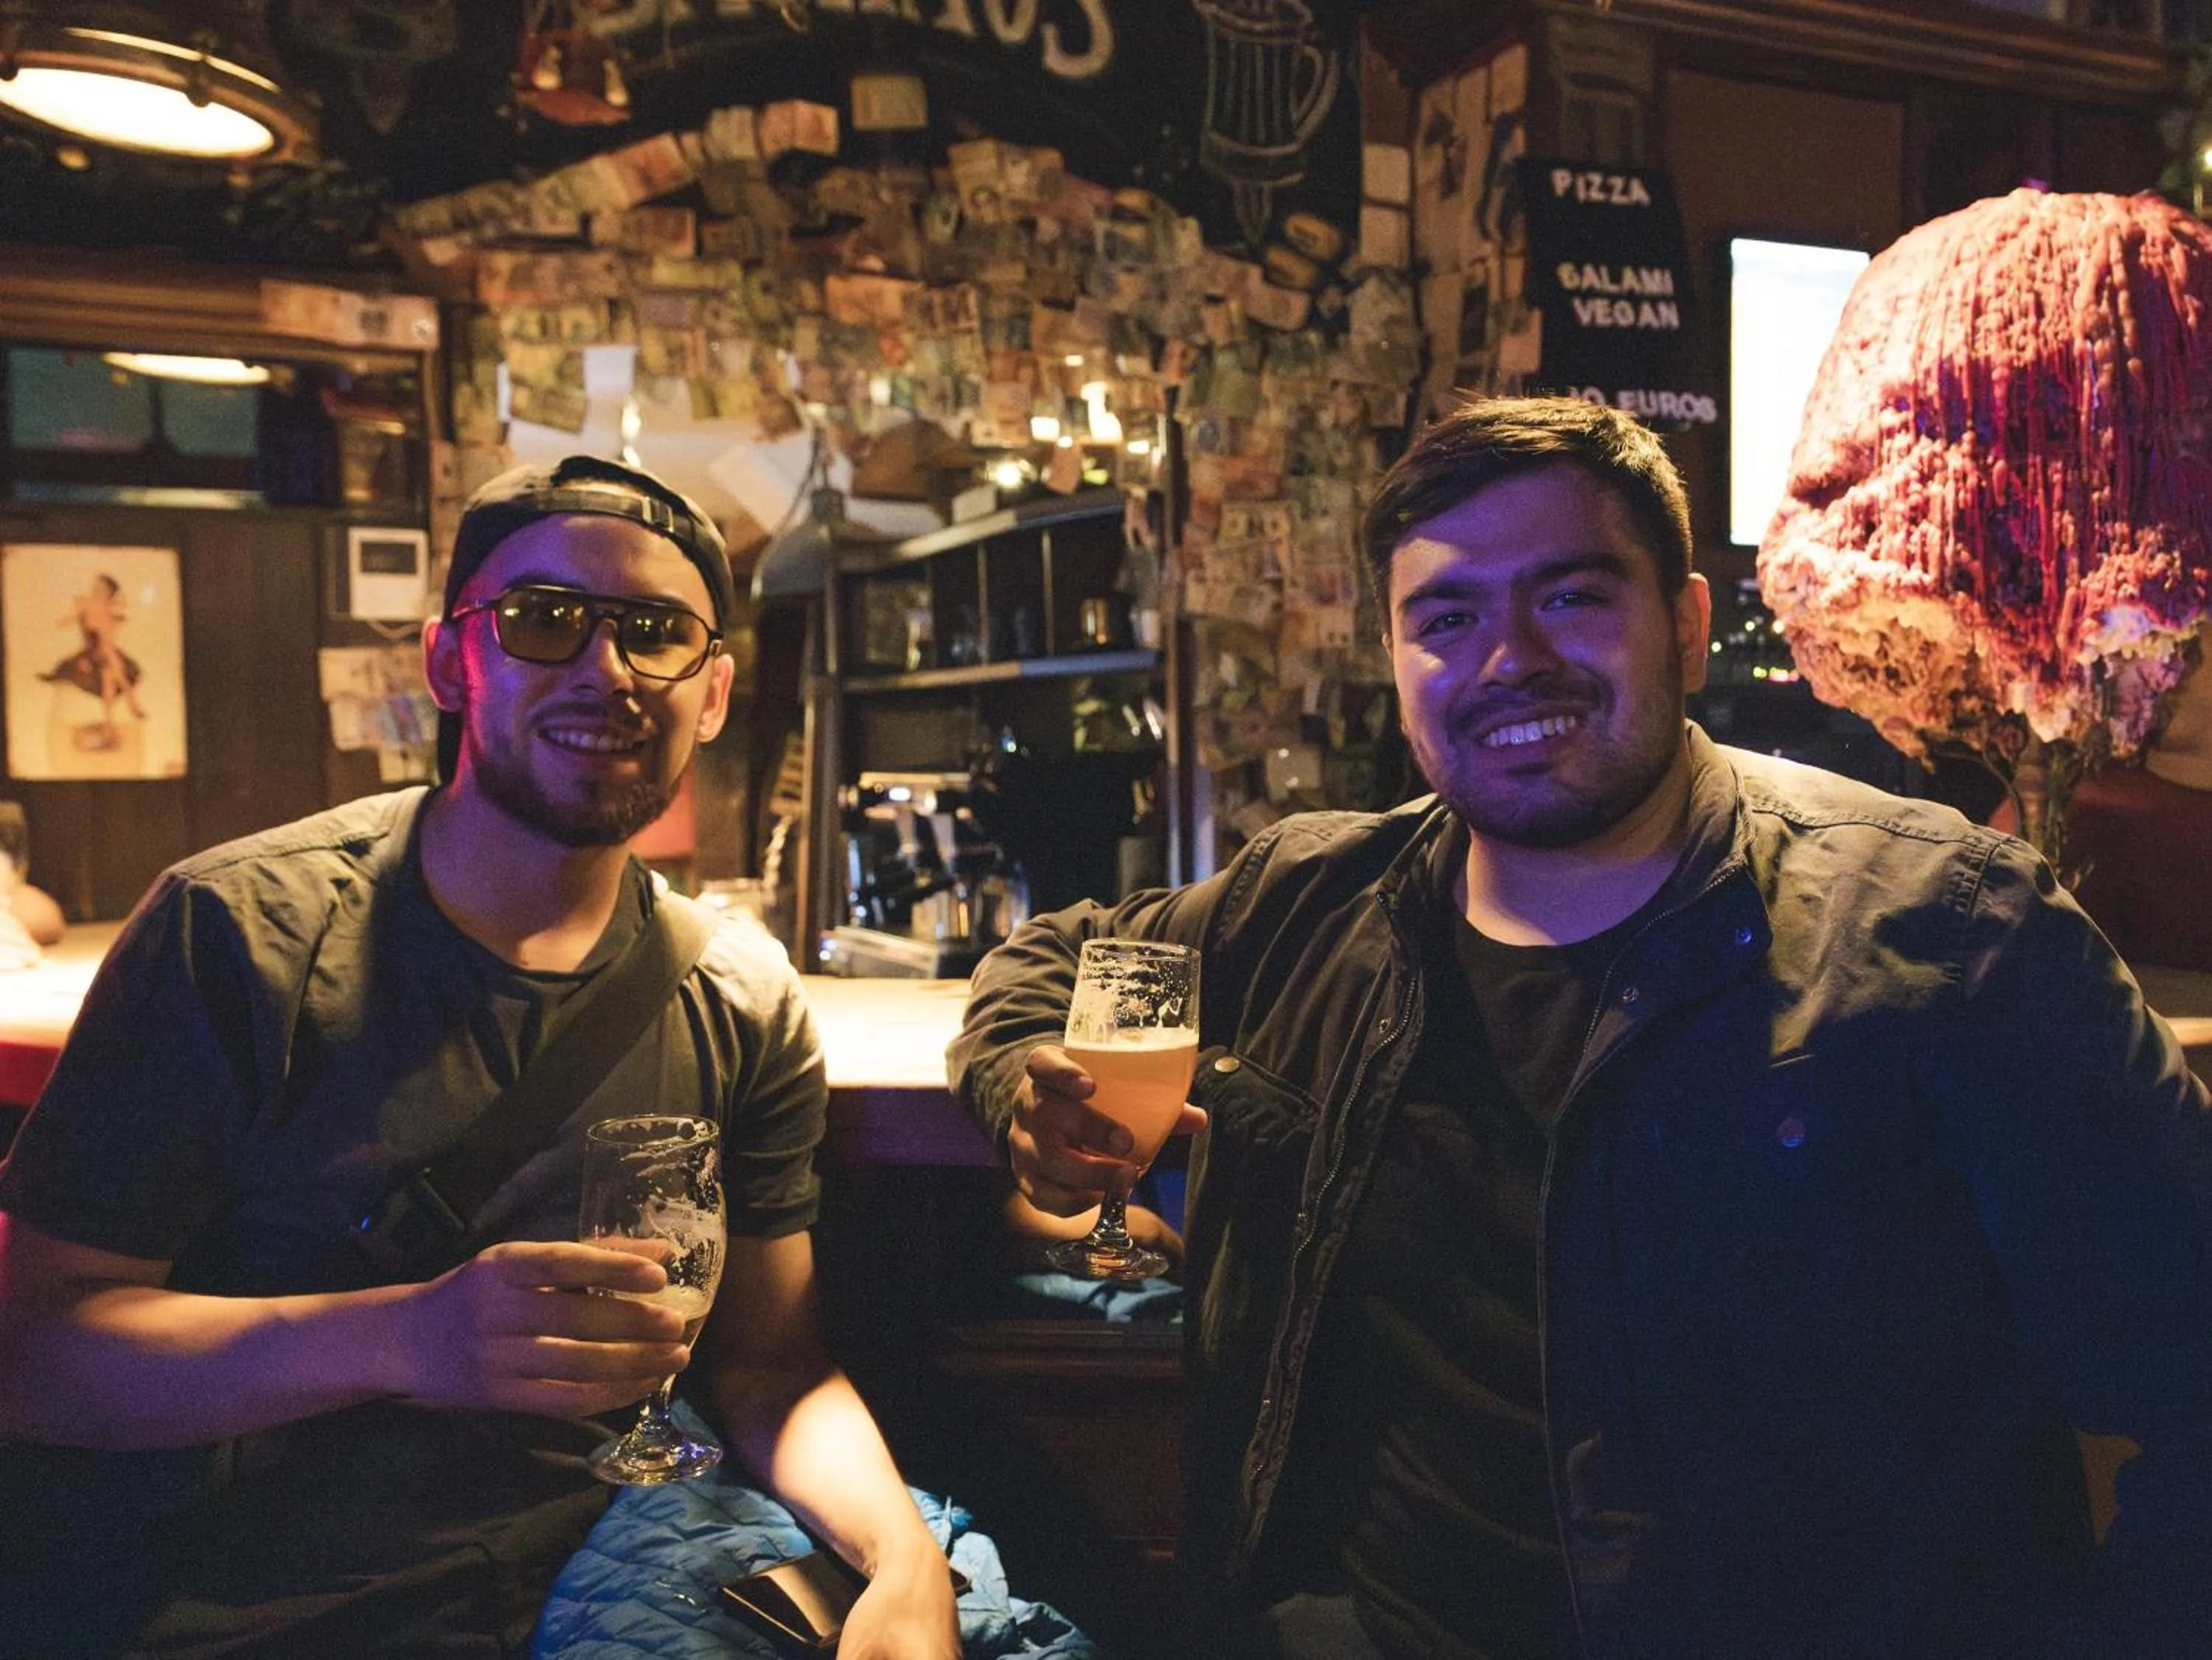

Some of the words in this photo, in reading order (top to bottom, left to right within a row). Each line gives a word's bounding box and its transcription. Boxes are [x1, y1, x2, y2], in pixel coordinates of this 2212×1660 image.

[1551, 168, 1652, 207] PIZZA
[1573, 298, 1680, 330] VEGAN
[1616, 389, 1717, 424] EUROS
